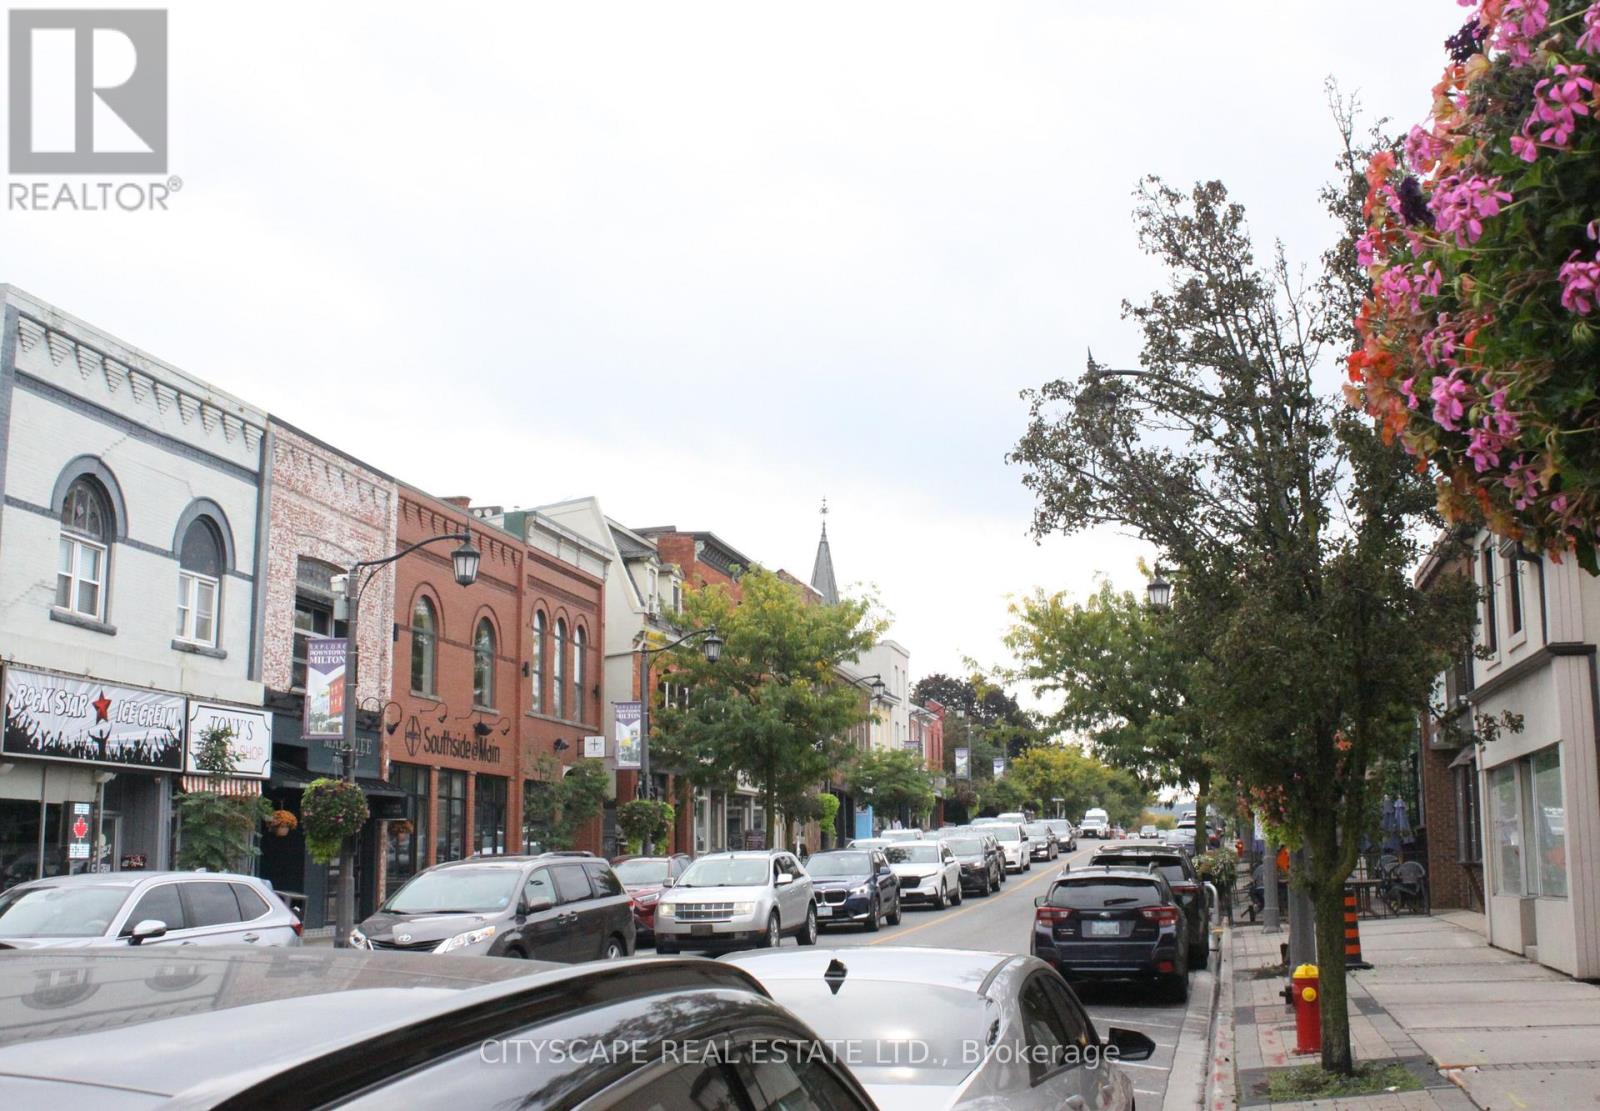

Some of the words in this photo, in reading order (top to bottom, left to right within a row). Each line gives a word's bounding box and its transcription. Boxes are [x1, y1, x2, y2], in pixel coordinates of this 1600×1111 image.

[309, 655, 346, 664] MILTON
[14, 683, 54, 714] ROCK
[55, 688, 89, 719] STAR
[116, 699, 137, 724] ICE
[138, 703, 180, 731] CREAM
